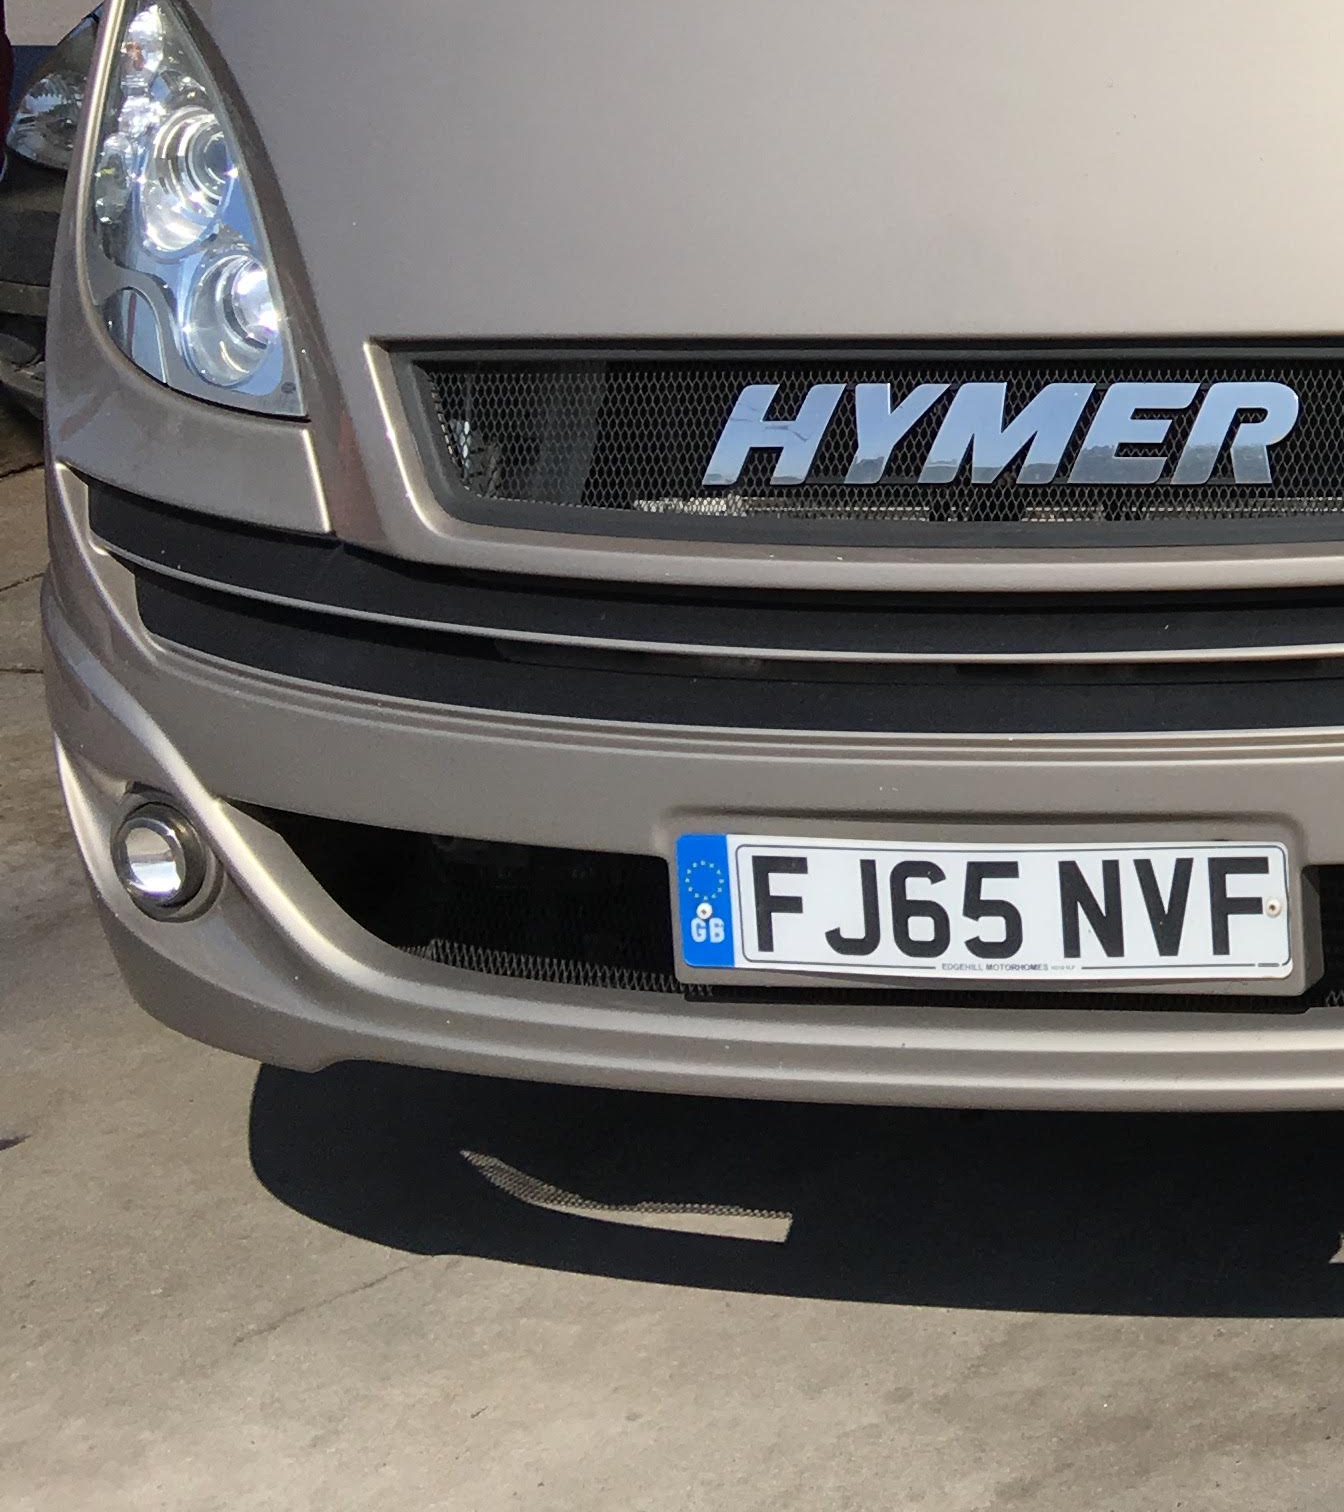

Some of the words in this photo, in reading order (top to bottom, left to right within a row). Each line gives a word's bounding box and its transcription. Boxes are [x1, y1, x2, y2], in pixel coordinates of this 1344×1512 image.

[702, 381, 1300, 486] HYMER
[690, 918, 726, 944] GB
[751, 855, 1024, 960] FJ65
[1058, 855, 1271, 960] NVF
[941, 963, 984, 972] EDGEHILL
[985, 963, 1050, 972] MOTORHOMES
